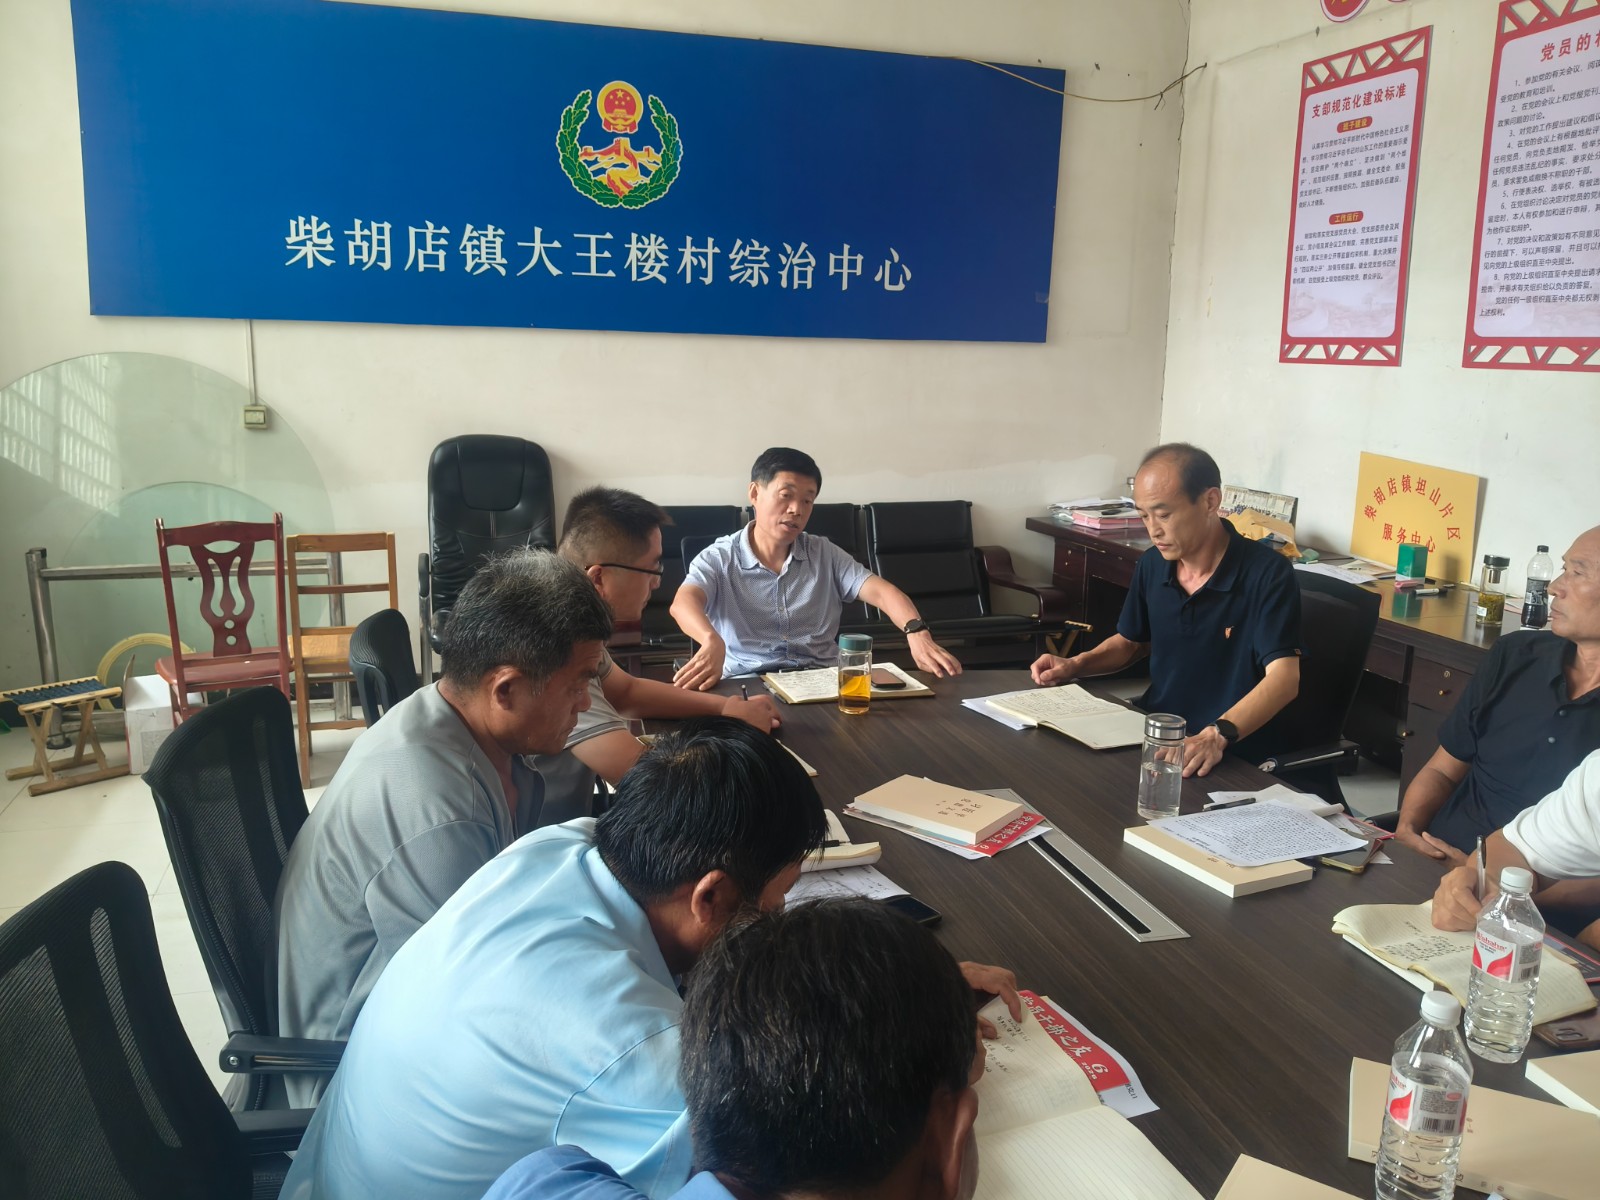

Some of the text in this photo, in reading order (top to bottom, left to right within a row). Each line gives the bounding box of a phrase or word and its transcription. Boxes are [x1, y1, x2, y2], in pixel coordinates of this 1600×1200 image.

[1312, 83, 1407, 119] 支部规范化建设标准
[1334, 213, 1359, 223] 工作运行
[285, 215, 912, 292] 柴胡店镇大王楼村综治中心
[1364, 474, 1461, 542] 柴胡店镇坦山片区
[1382, 523, 1436, 553] 服务中心
[1091, 1063, 1109, 1074] 6
